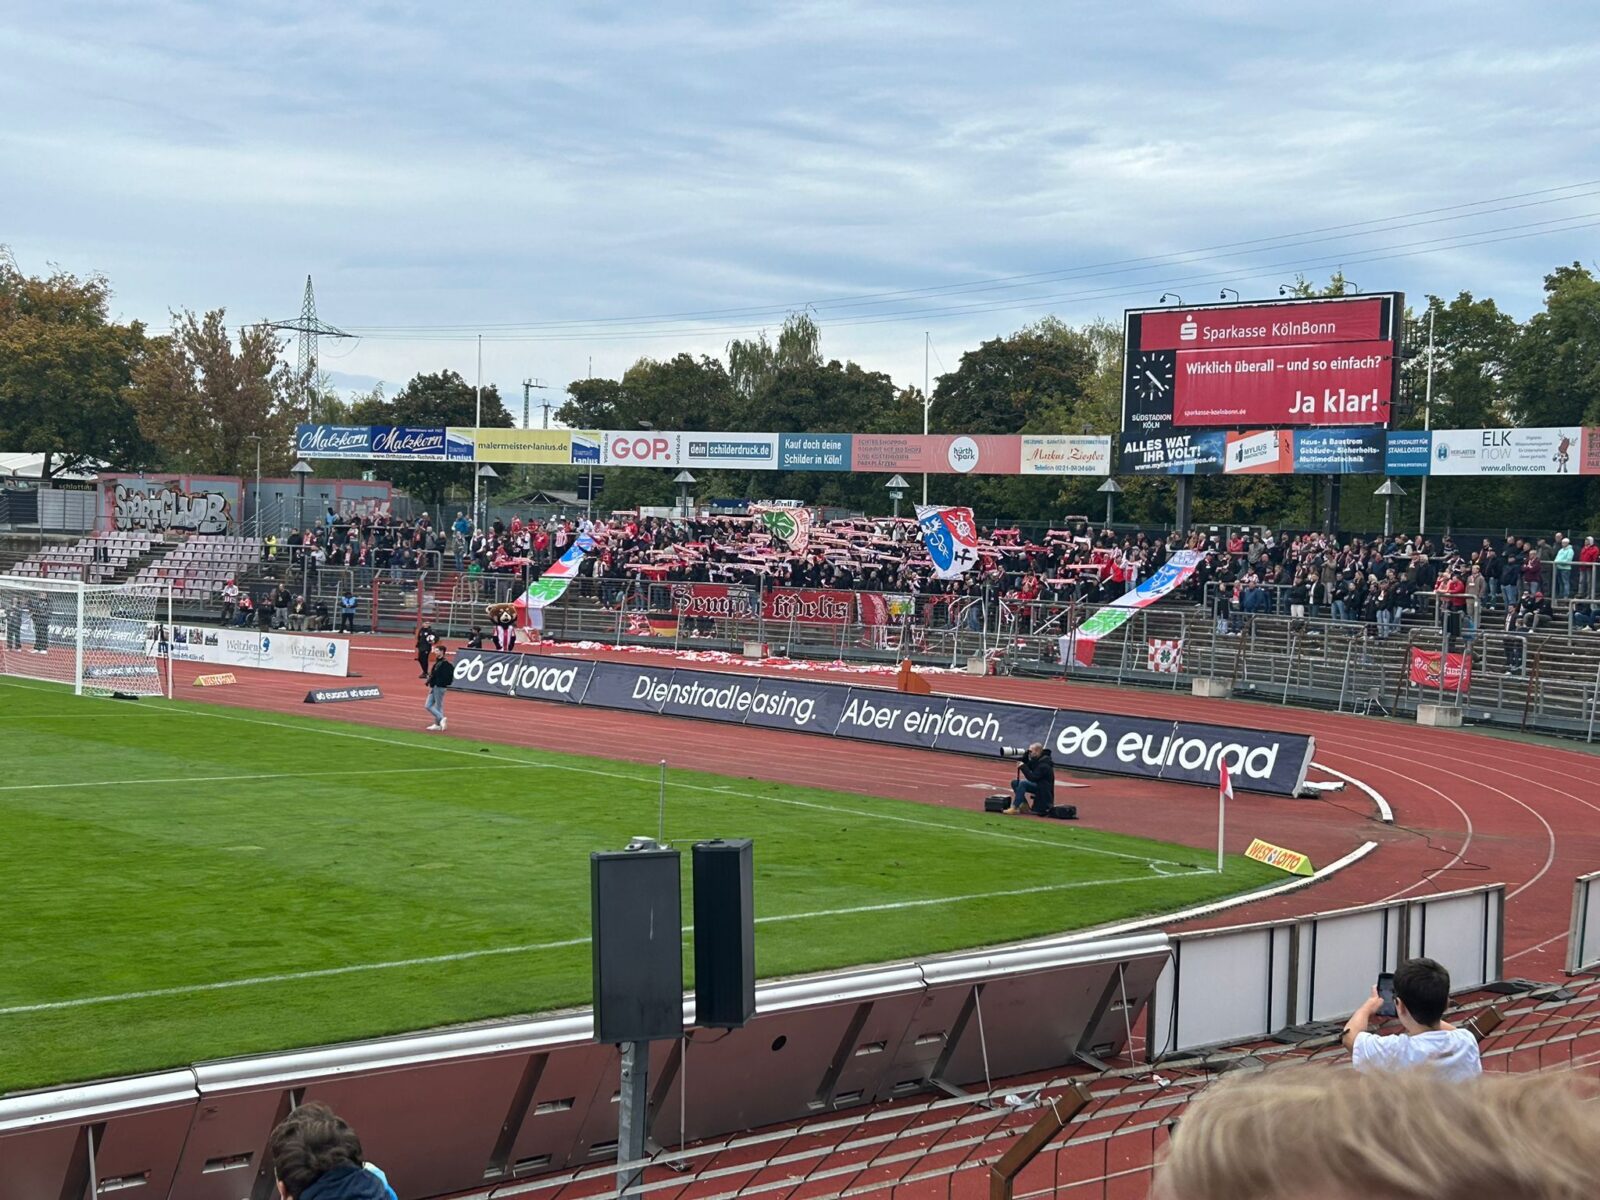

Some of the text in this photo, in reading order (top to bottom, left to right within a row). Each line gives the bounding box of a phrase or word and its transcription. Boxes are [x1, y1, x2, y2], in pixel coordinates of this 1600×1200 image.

[1203, 321, 1336, 340] Sparkasse KölnBonn
[1186, 362, 1232, 375] Wirklich
[1235, 359, 1274, 373] überall
[1287, 359, 1308, 371] und
[1312, 361, 1327, 370] so
[1330, 355, 1381, 369] einfach?
[1289, 388, 1378, 414] Ja klar!
[1131, 413, 1172, 421] SÜDSTADION
[1142, 421, 1160, 429] KÖLN
[299, 425, 369, 451] Malzkorn
[372, 426, 444, 452] Malzkorn
[478, 442, 568, 451] malermeister-lanius.de
[785, 439, 842, 450] Kauf doch deine
[1124, 435, 1191, 454] ALLES WAT
[1482, 431, 1512, 447] ELK
[612, 437, 671, 460] GOP.
[690, 444, 706, 455] dein
[709, 444, 769, 456] schilderdruck.de
[1143, 445, 1201, 463] IHR VOLT!
[1481, 447, 1512, 460] now
[784, 454, 842, 465] Schilder in Köln!
[1481, 463, 1546, 472] www.elknow.com
[487, 661, 578, 693] eurorad
[632, 675, 817, 725] Dienstradleasing.
[840, 698, 1004, 742] Aber einfach.
[1116, 732, 1280, 779] eurorad
